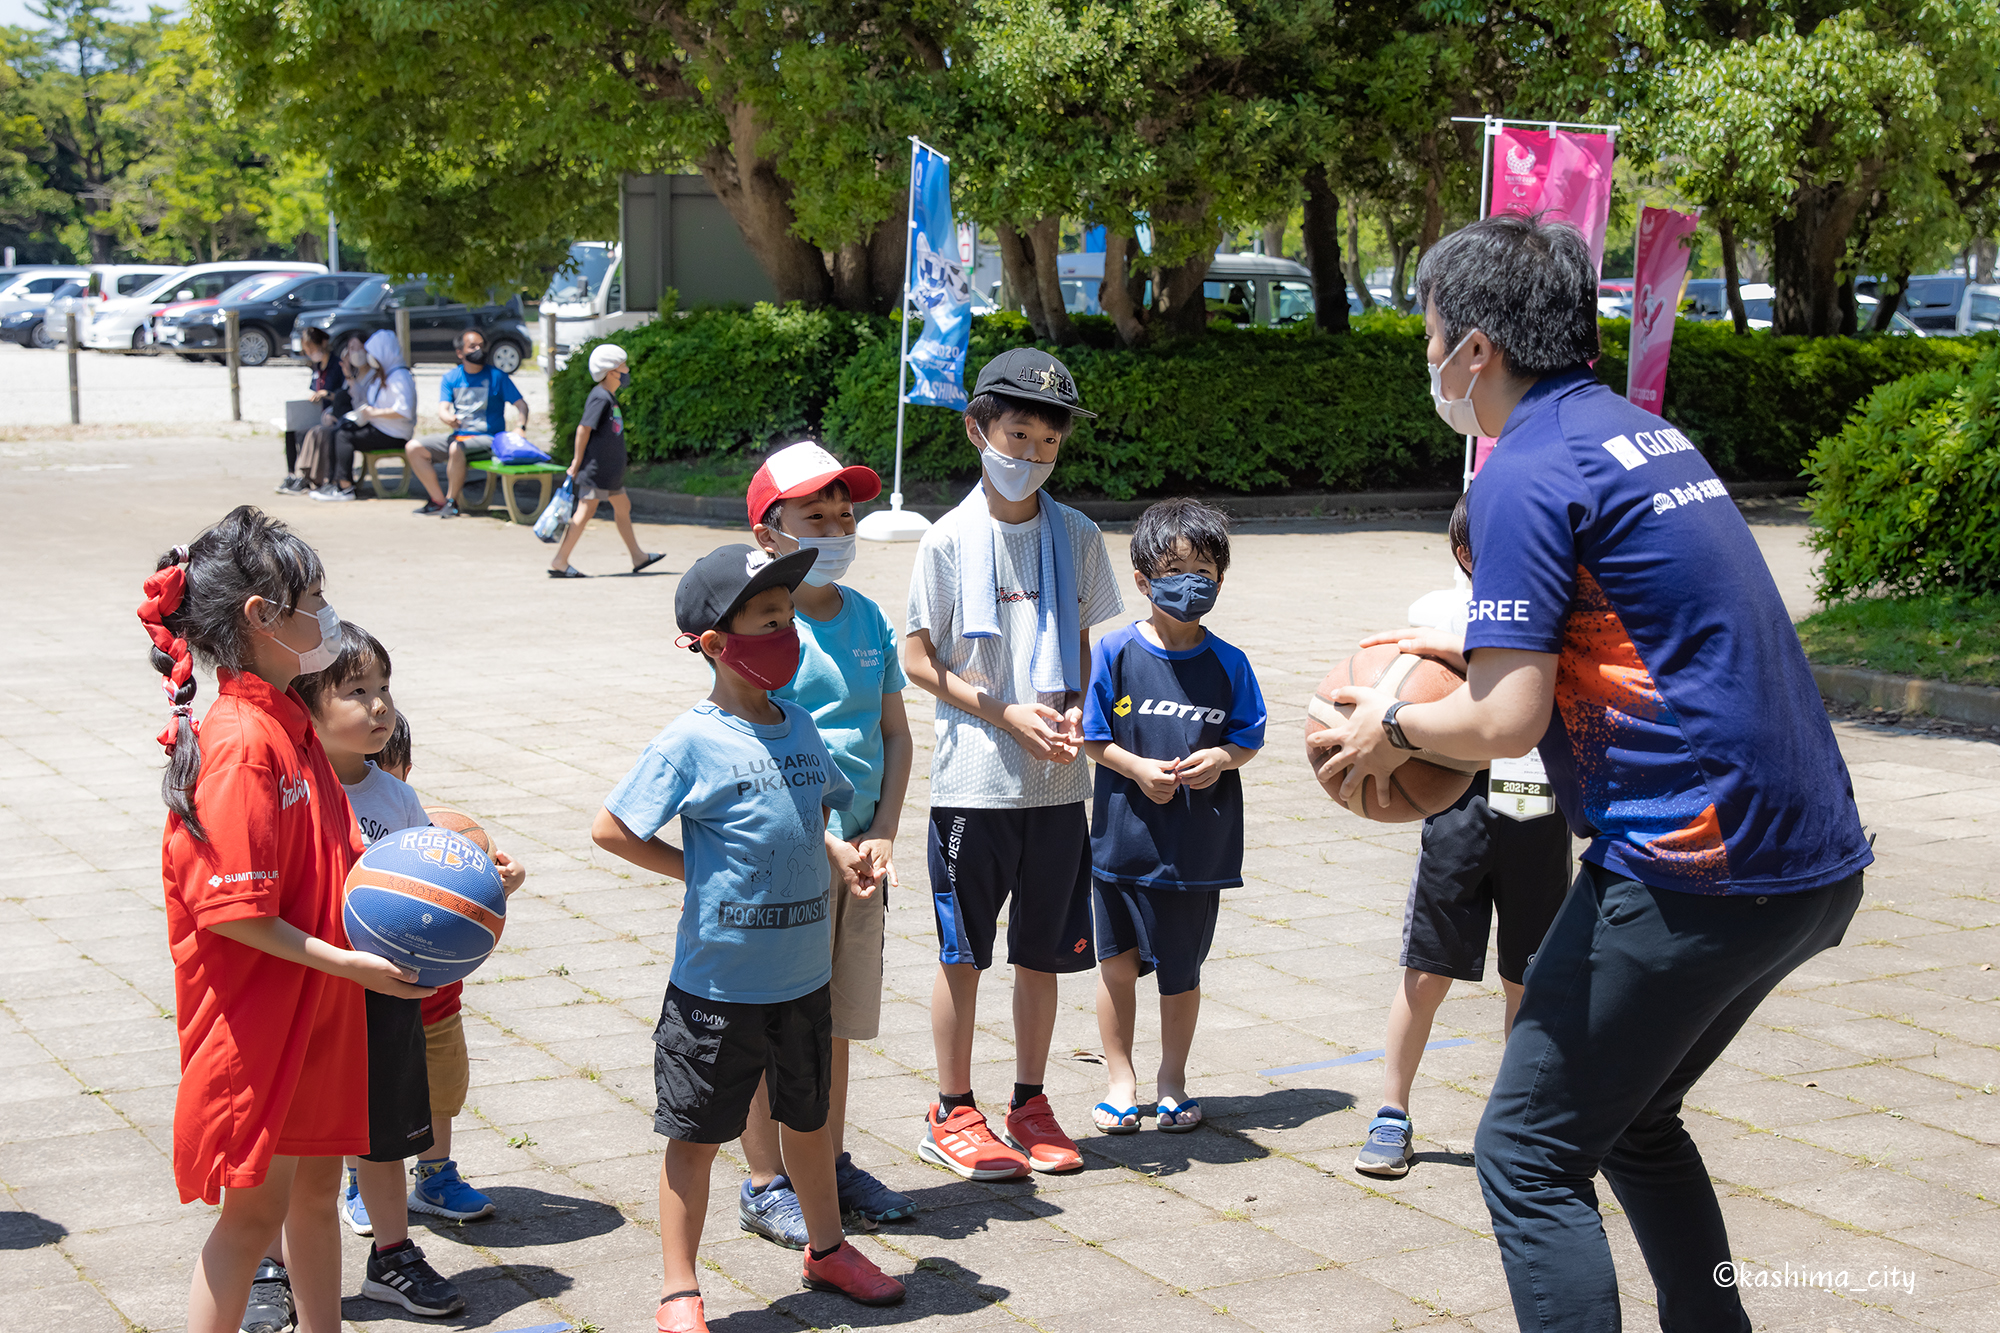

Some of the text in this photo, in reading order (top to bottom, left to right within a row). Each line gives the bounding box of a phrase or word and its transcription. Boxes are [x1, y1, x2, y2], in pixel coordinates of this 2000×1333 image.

[1017, 366, 1045, 384] ALL
[1138, 699, 1226, 725] LOTTO
[732, 753, 820, 779] LUCARIO
[736, 771, 827, 797] PIKACHU
[1503, 781, 1541, 795] 2021-22
[948, 815, 967, 860] DESIGN
[402, 832, 486, 871] ROBOTS
[224, 870, 267, 883] SUMITOMO
[387, 875, 444, 902] ROBOTS
[723, 905, 783, 927] POCKET
